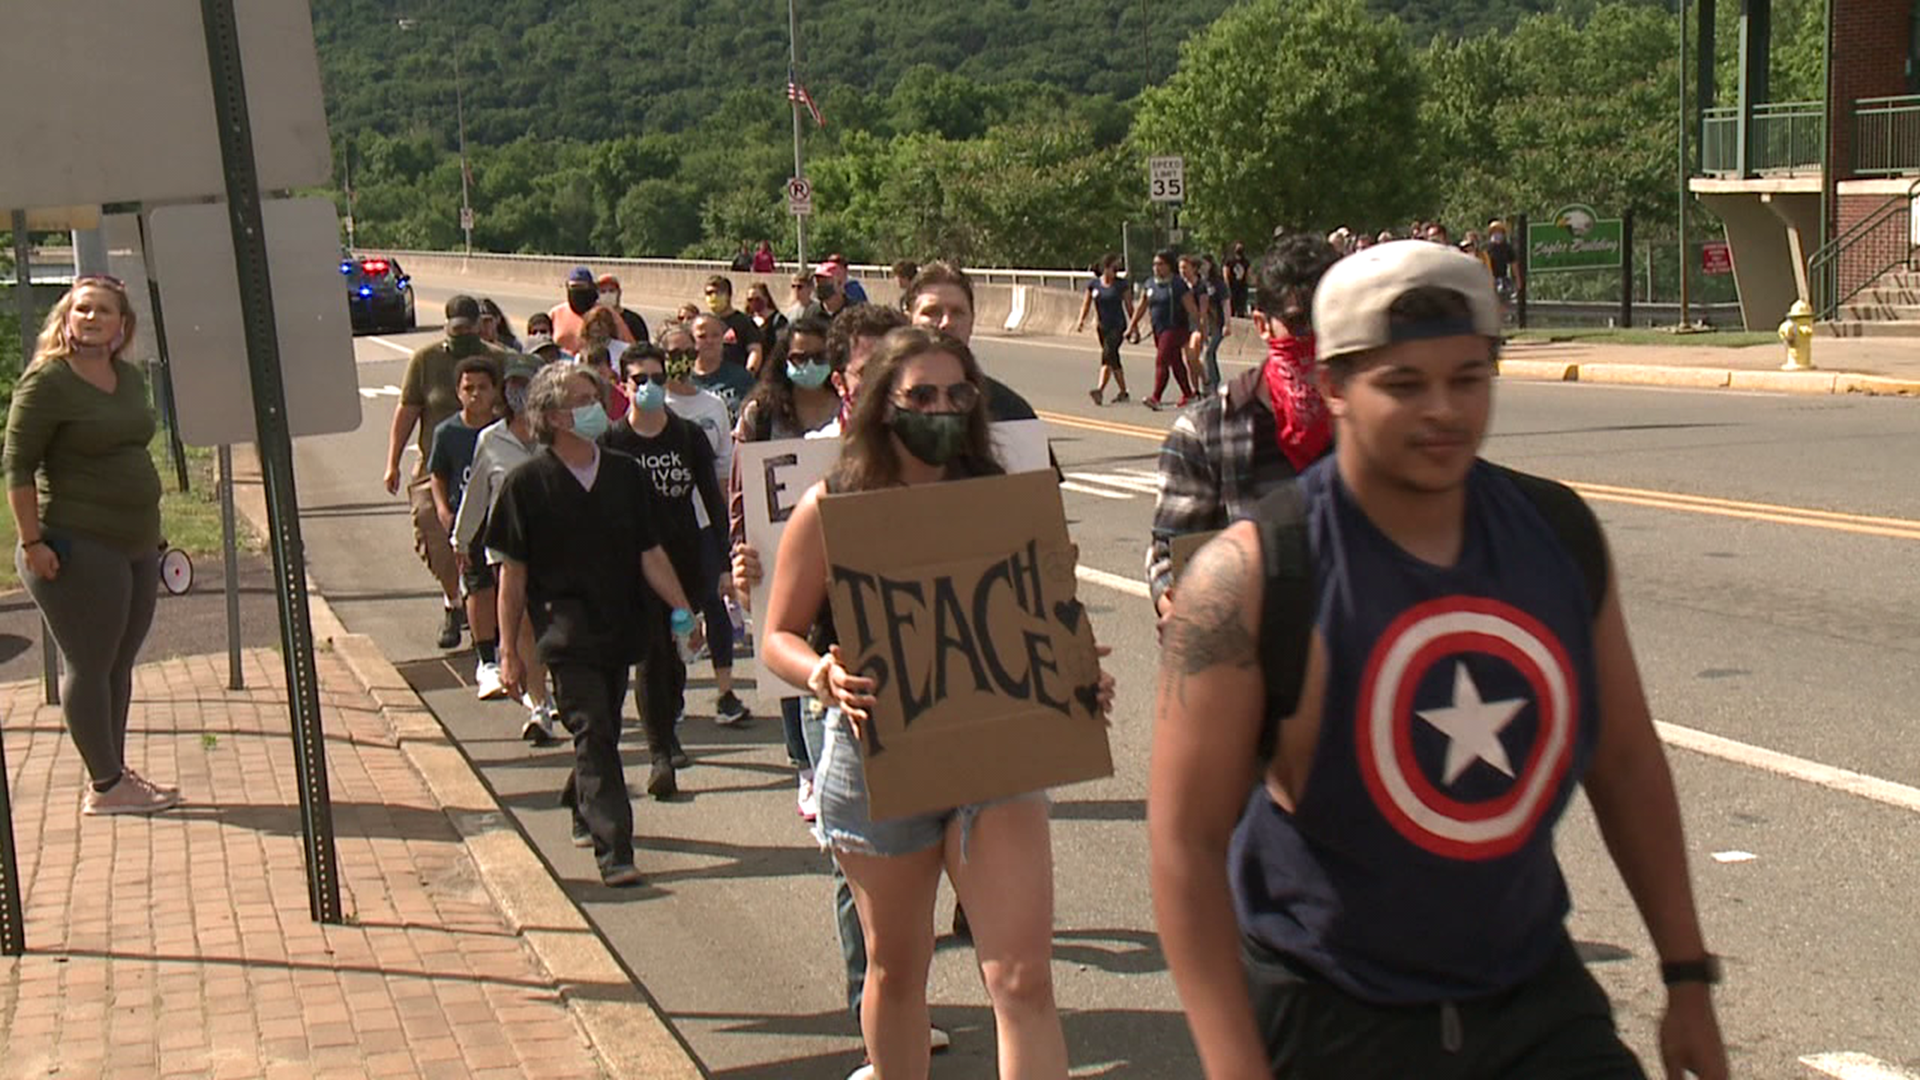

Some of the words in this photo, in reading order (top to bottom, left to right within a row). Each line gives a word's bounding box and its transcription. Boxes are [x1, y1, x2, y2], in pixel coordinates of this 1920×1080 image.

[1152, 160, 1181, 169] SPEED
[1154, 170, 1178, 178] LIMIT
[1153, 179, 1181, 196] 35
[651, 468, 692, 482] ives
[831, 539, 1047, 728] TEACH
